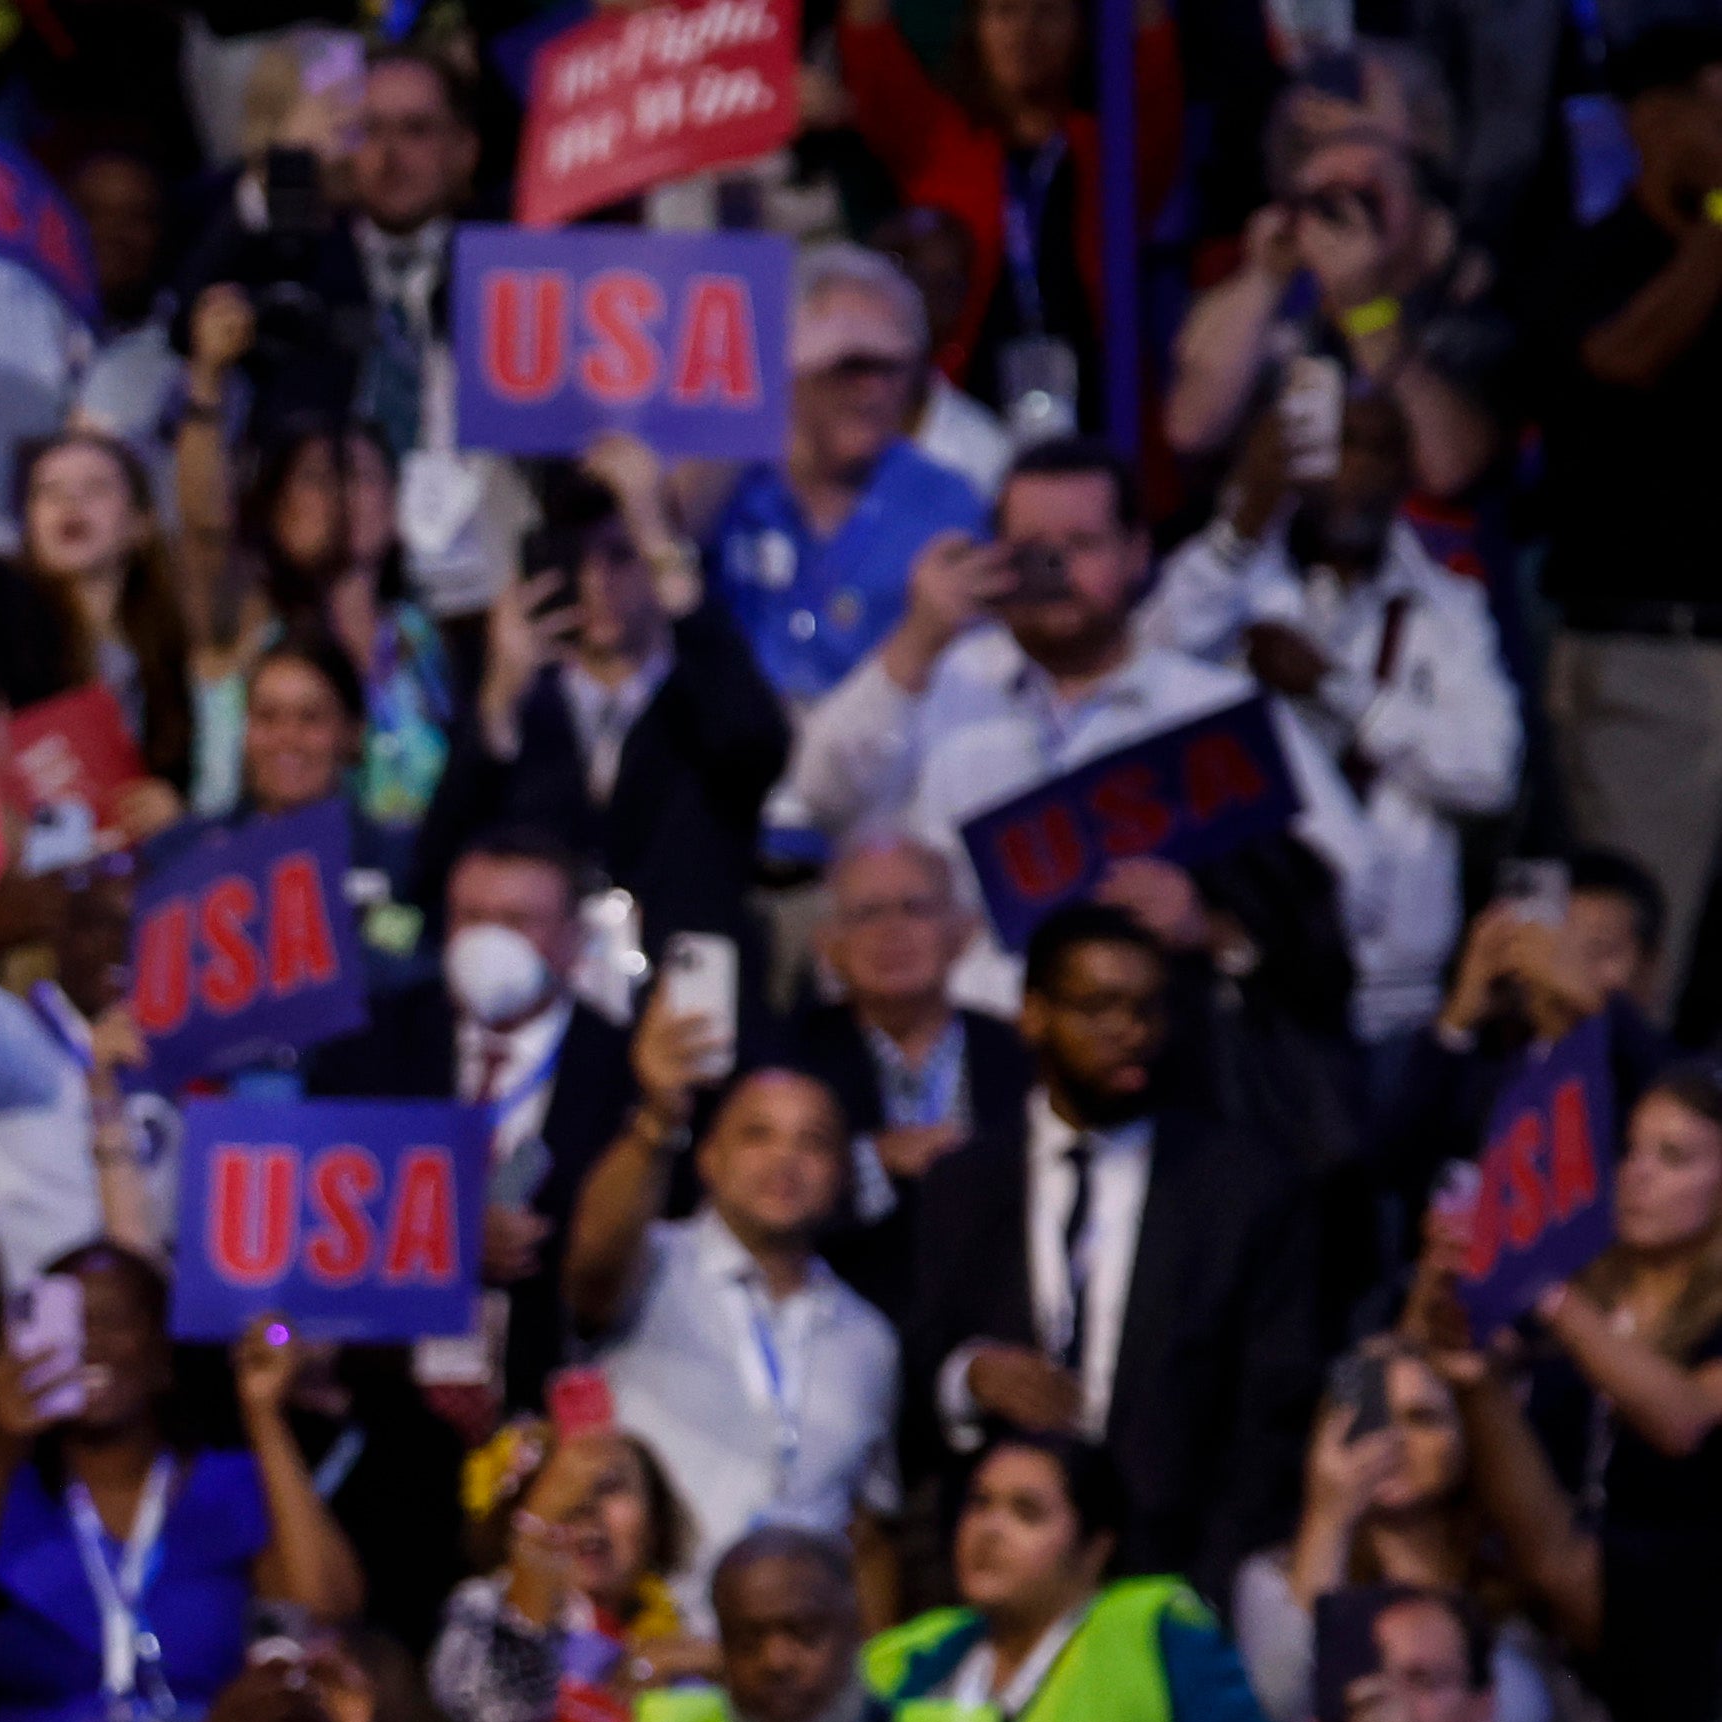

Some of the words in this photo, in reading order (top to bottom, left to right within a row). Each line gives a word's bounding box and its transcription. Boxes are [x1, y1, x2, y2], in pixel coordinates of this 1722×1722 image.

[478, 268, 759, 410] USA
[996, 732, 1269, 900] USA
[132, 853, 340, 1036] USA
[207, 1143, 462, 1287] USA
